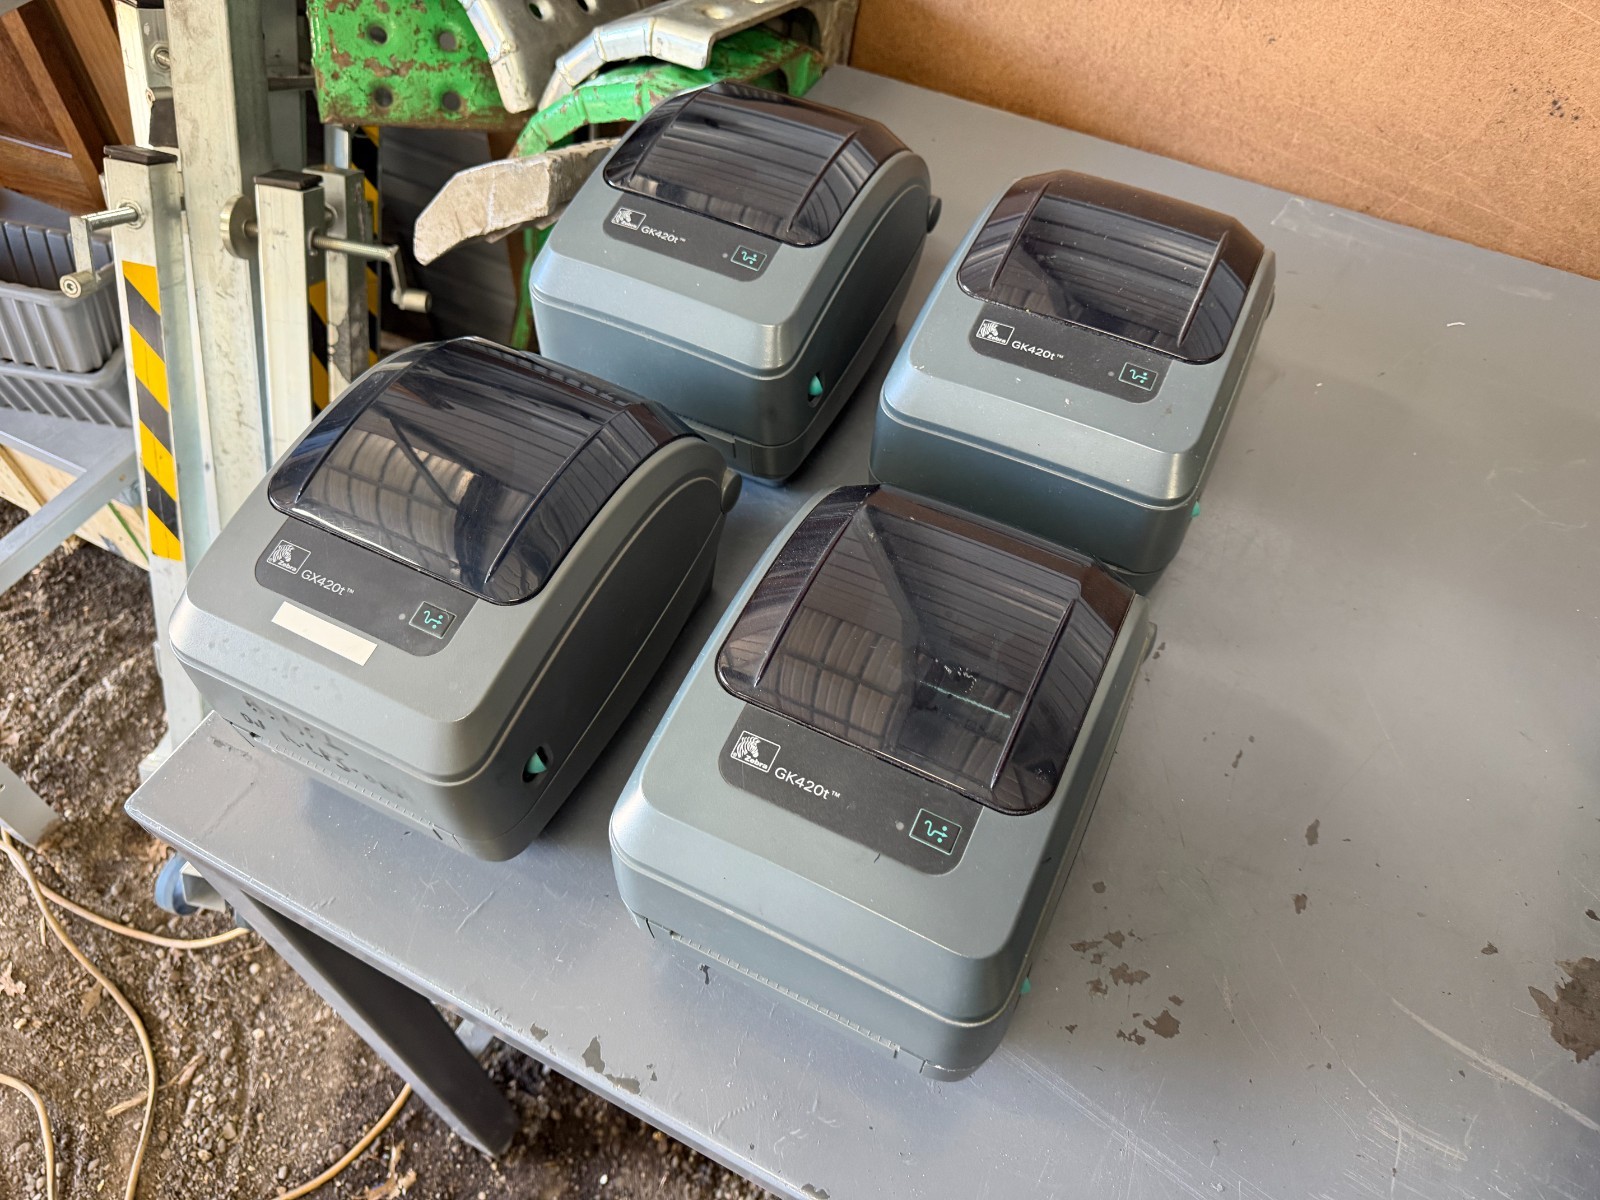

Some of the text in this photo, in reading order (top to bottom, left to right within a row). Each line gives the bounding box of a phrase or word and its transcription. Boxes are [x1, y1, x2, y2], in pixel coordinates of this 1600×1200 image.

[987, 334, 1006, 344] Zebra
[277, 559, 297, 572] Zebra
[744, 754, 769, 770] Zebra
